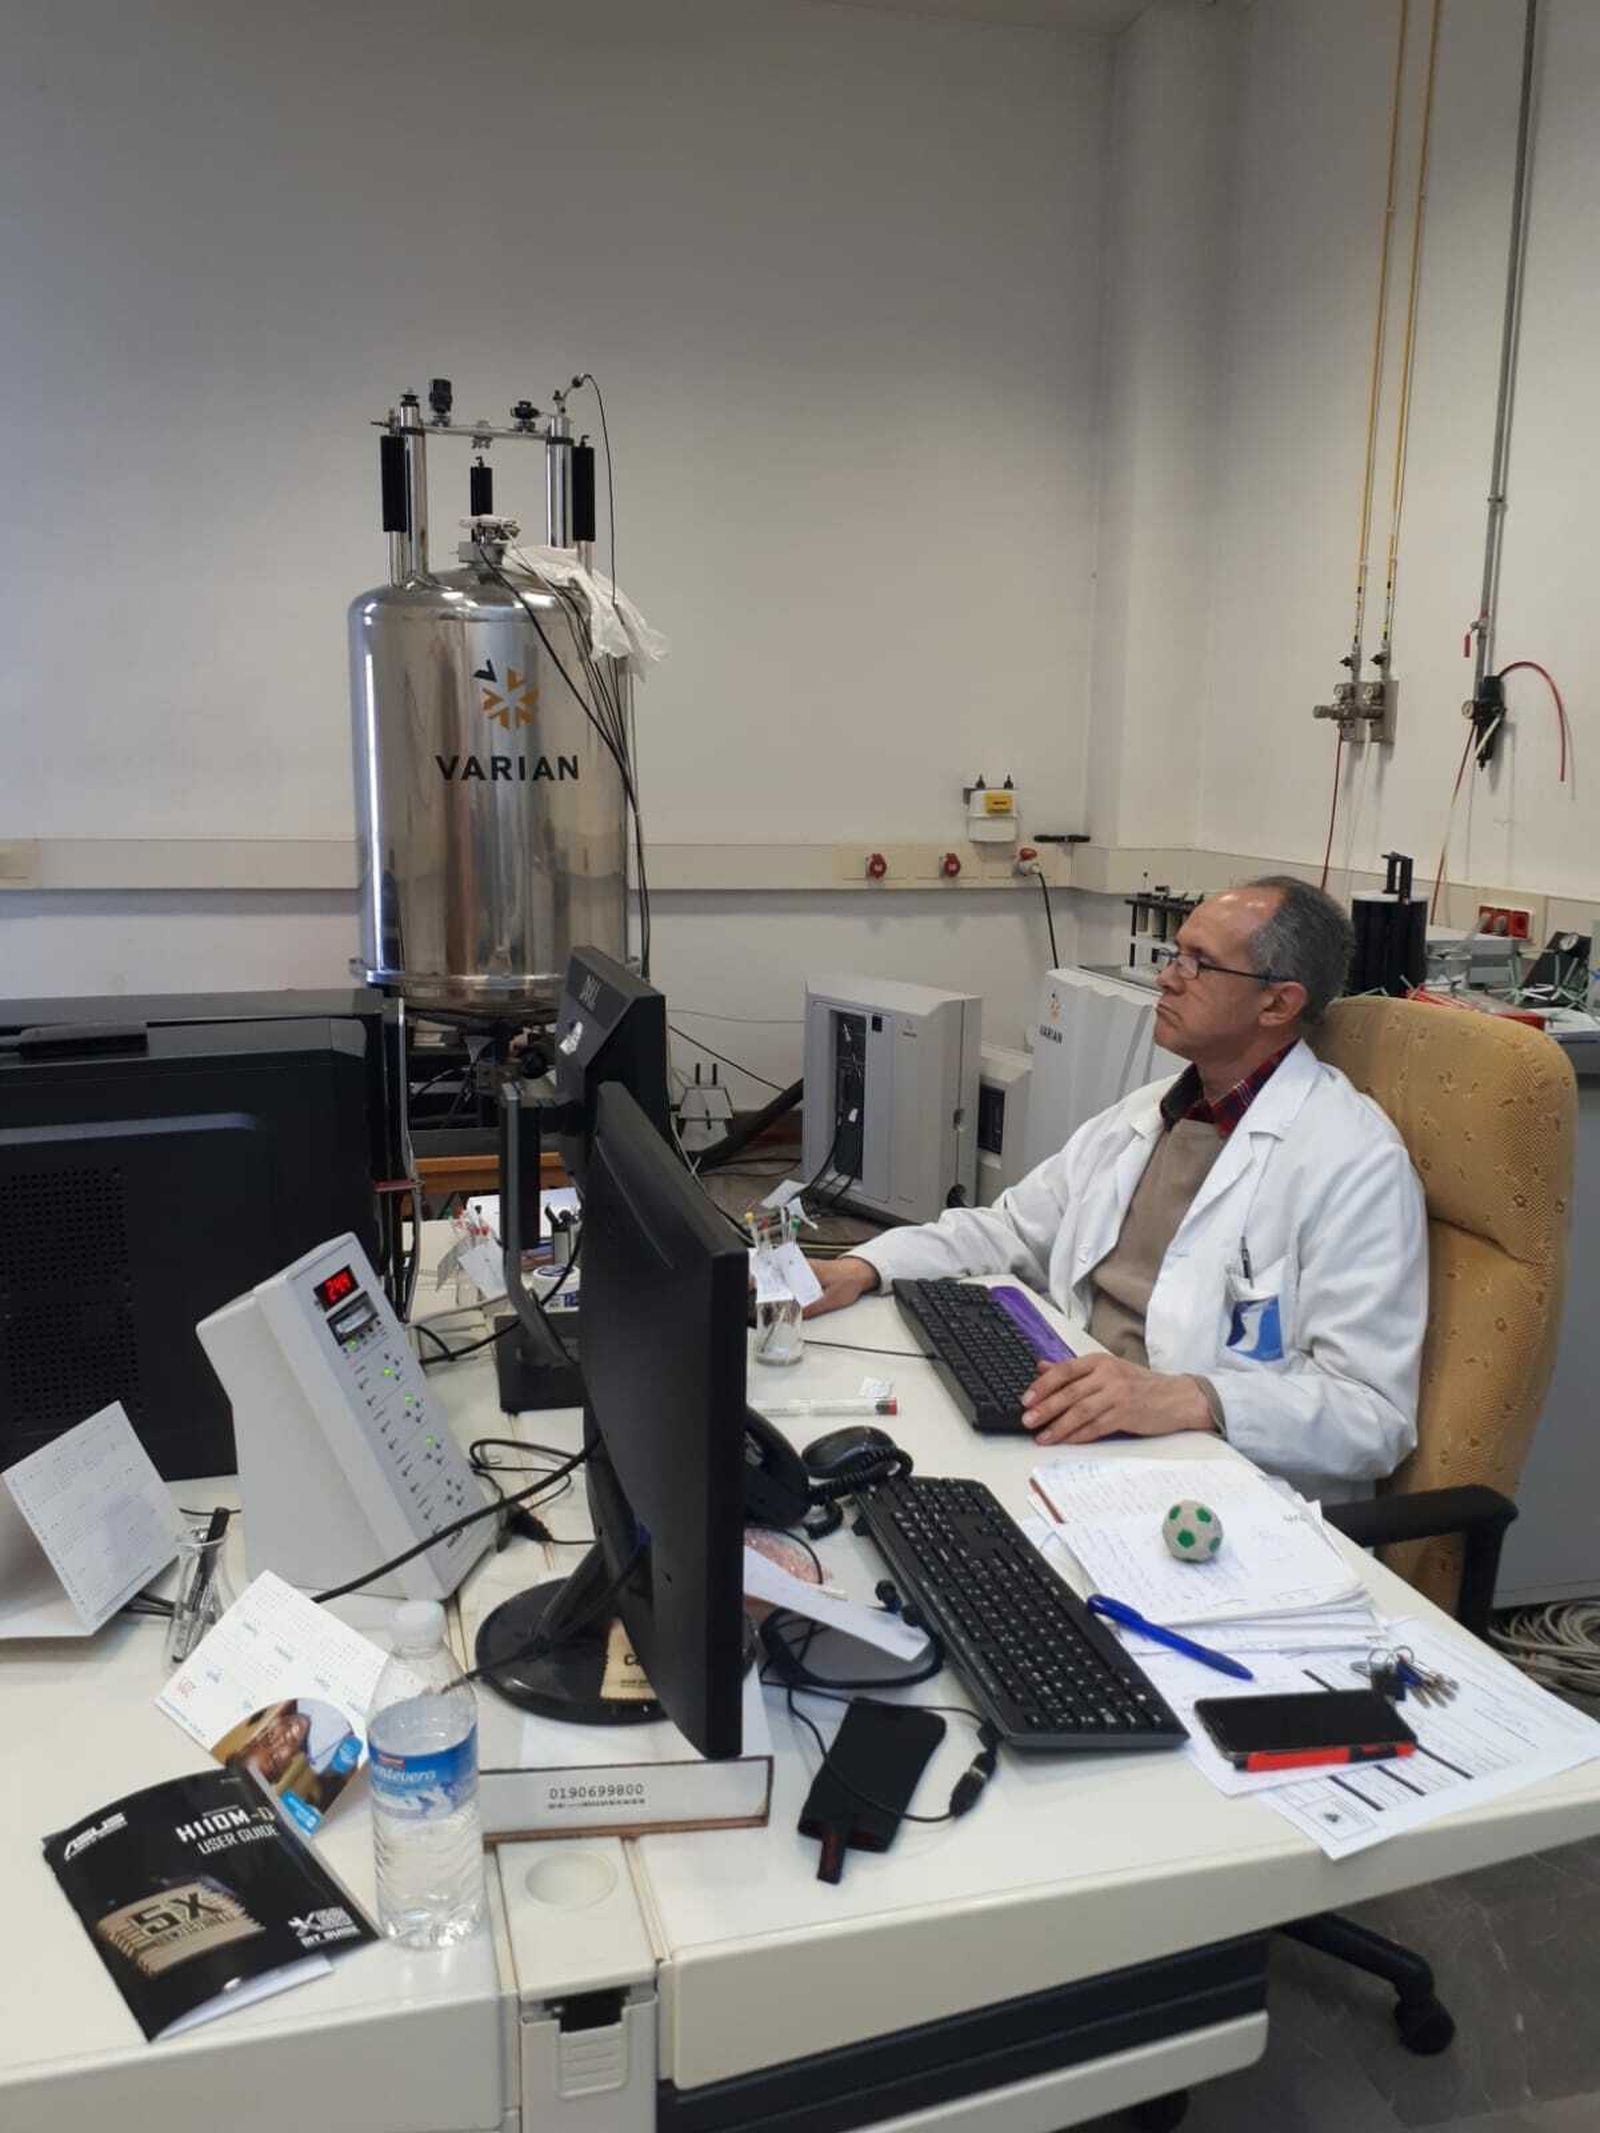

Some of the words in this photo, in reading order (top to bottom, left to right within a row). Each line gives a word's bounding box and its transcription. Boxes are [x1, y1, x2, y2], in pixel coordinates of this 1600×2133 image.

[435, 755, 580, 781] VARIAN
[549, 1784, 644, 1799] 0190699800
[64, 1813, 128, 1861] ASUS
[197, 1833, 237, 1855] USER
[236, 1824, 279, 1843] GUIDE
[133, 1892, 223, 1935] 5X
